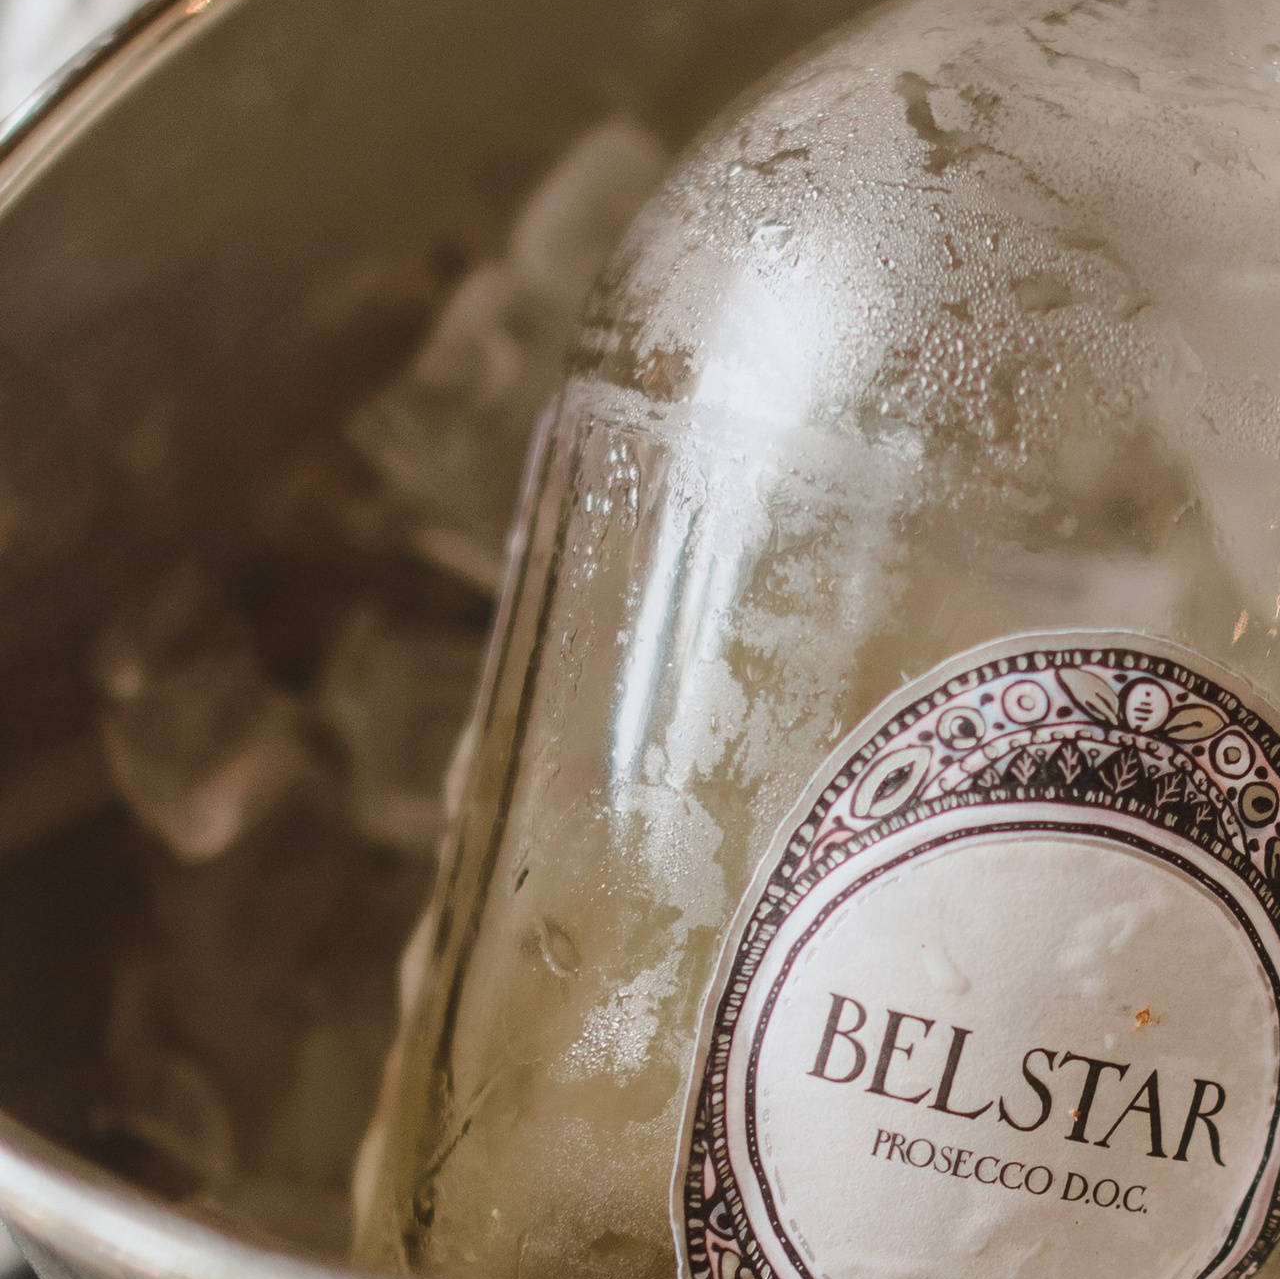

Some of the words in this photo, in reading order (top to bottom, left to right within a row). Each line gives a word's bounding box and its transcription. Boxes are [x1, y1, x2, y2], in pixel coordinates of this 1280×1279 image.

[806, 992, 1227, 1166] BELSTAR
[870, 1128, 1054, 1196] PROSECCO
[1060, 1172, 1149, 1214] D.O.C.
